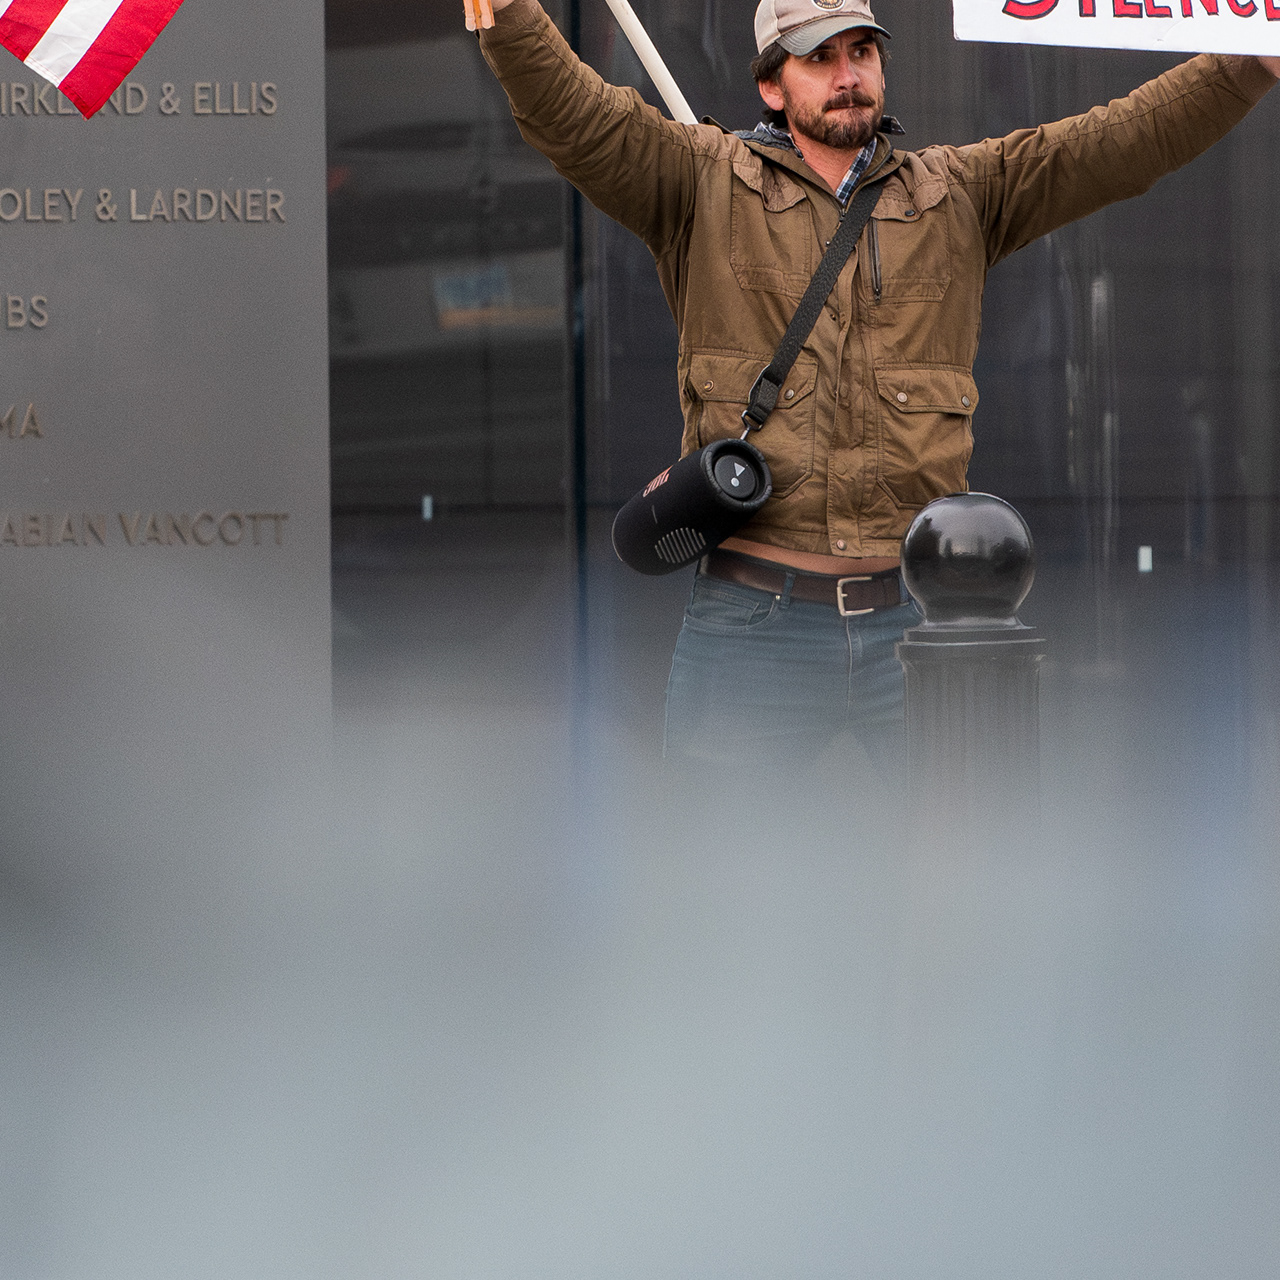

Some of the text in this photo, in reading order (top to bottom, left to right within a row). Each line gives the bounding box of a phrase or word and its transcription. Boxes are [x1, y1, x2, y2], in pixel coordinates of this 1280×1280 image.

[159, 82, 182, 116] &
[193, 82, 279, 116] ELLIS
[94, 188, 118, 222] &
[130, 188, 286, 222] LARDNER
